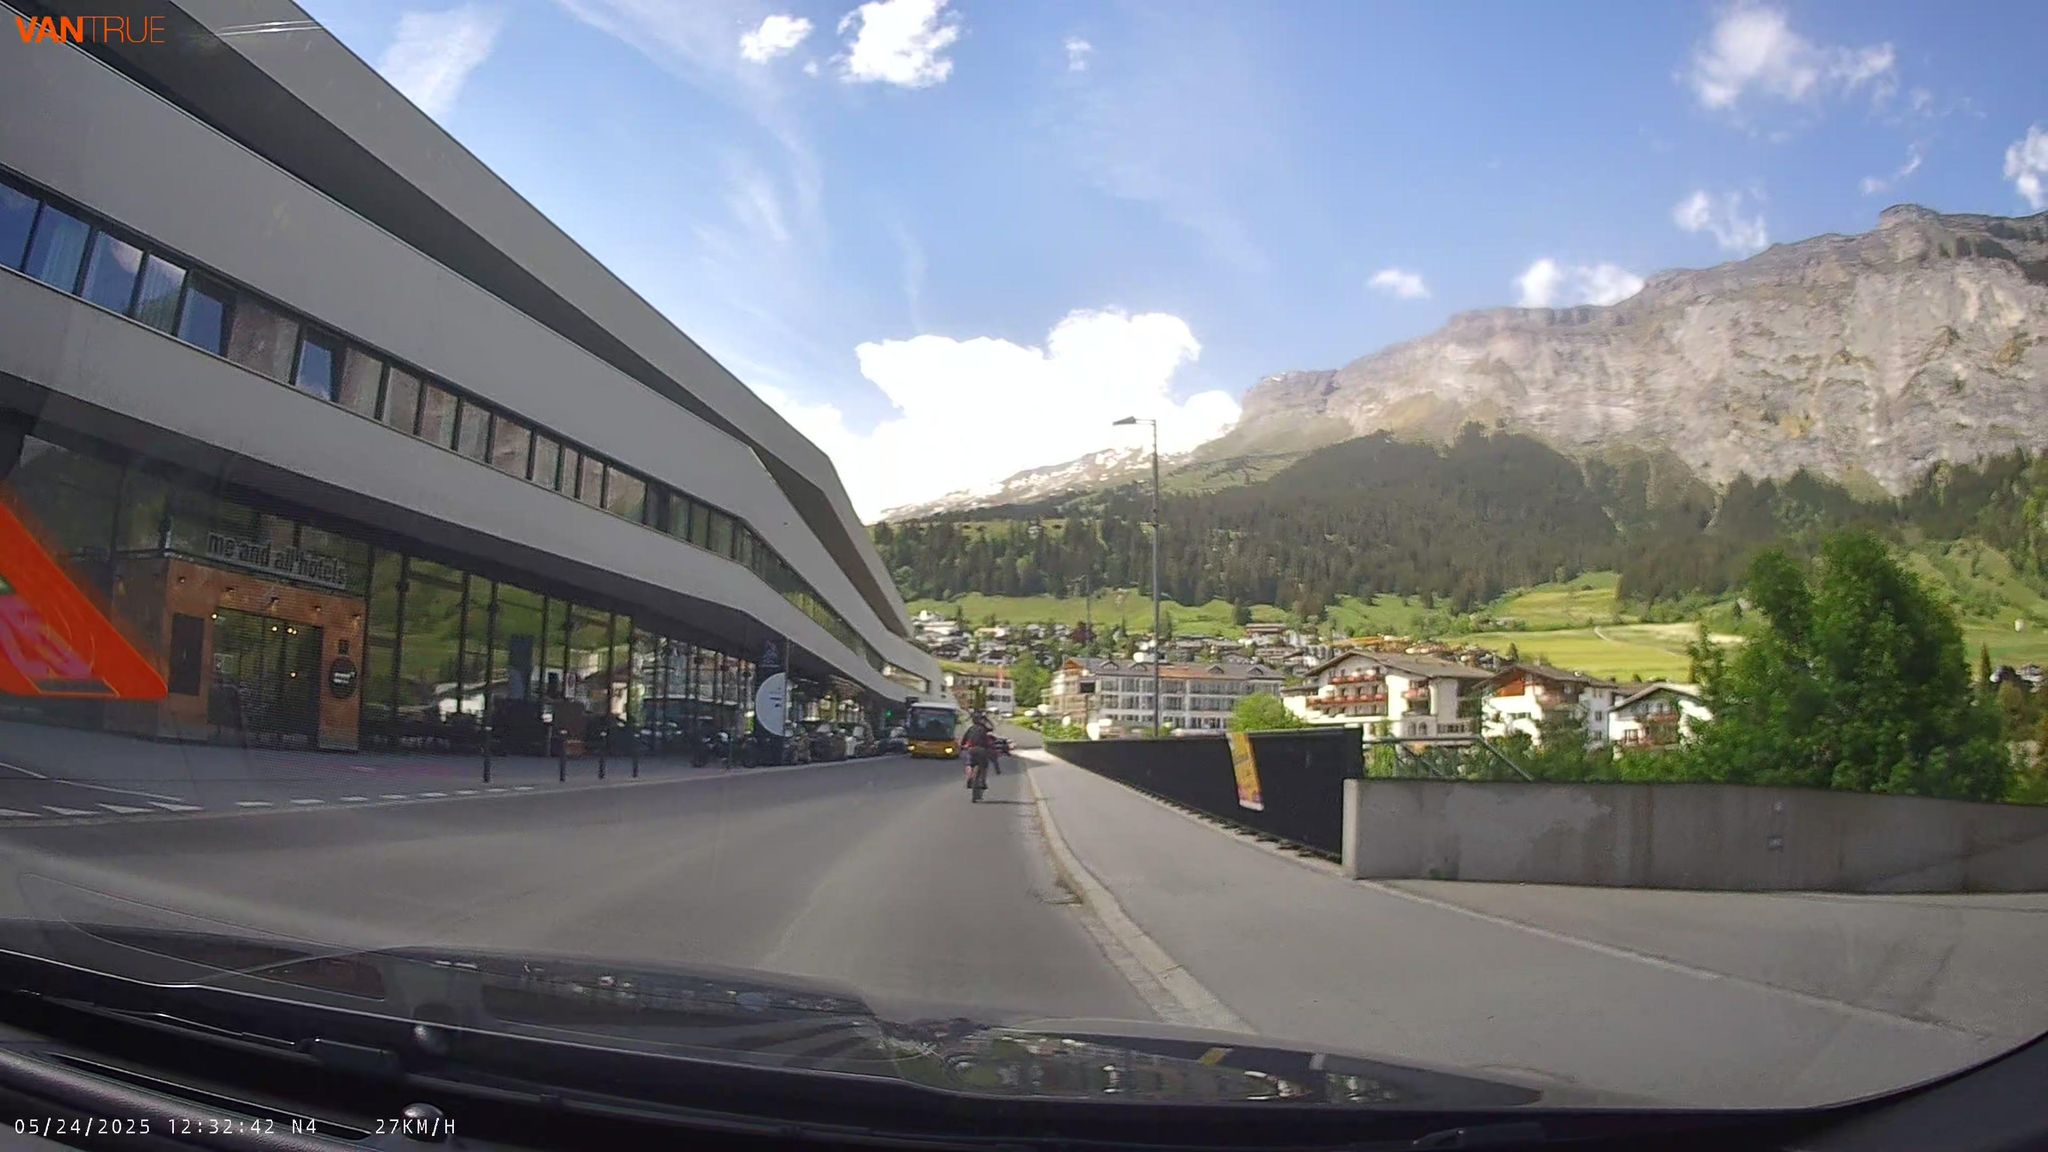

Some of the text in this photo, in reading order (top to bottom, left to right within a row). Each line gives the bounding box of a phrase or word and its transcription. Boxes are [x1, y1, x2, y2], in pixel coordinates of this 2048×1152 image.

[207, 531, 347, 585] me and all hotels
